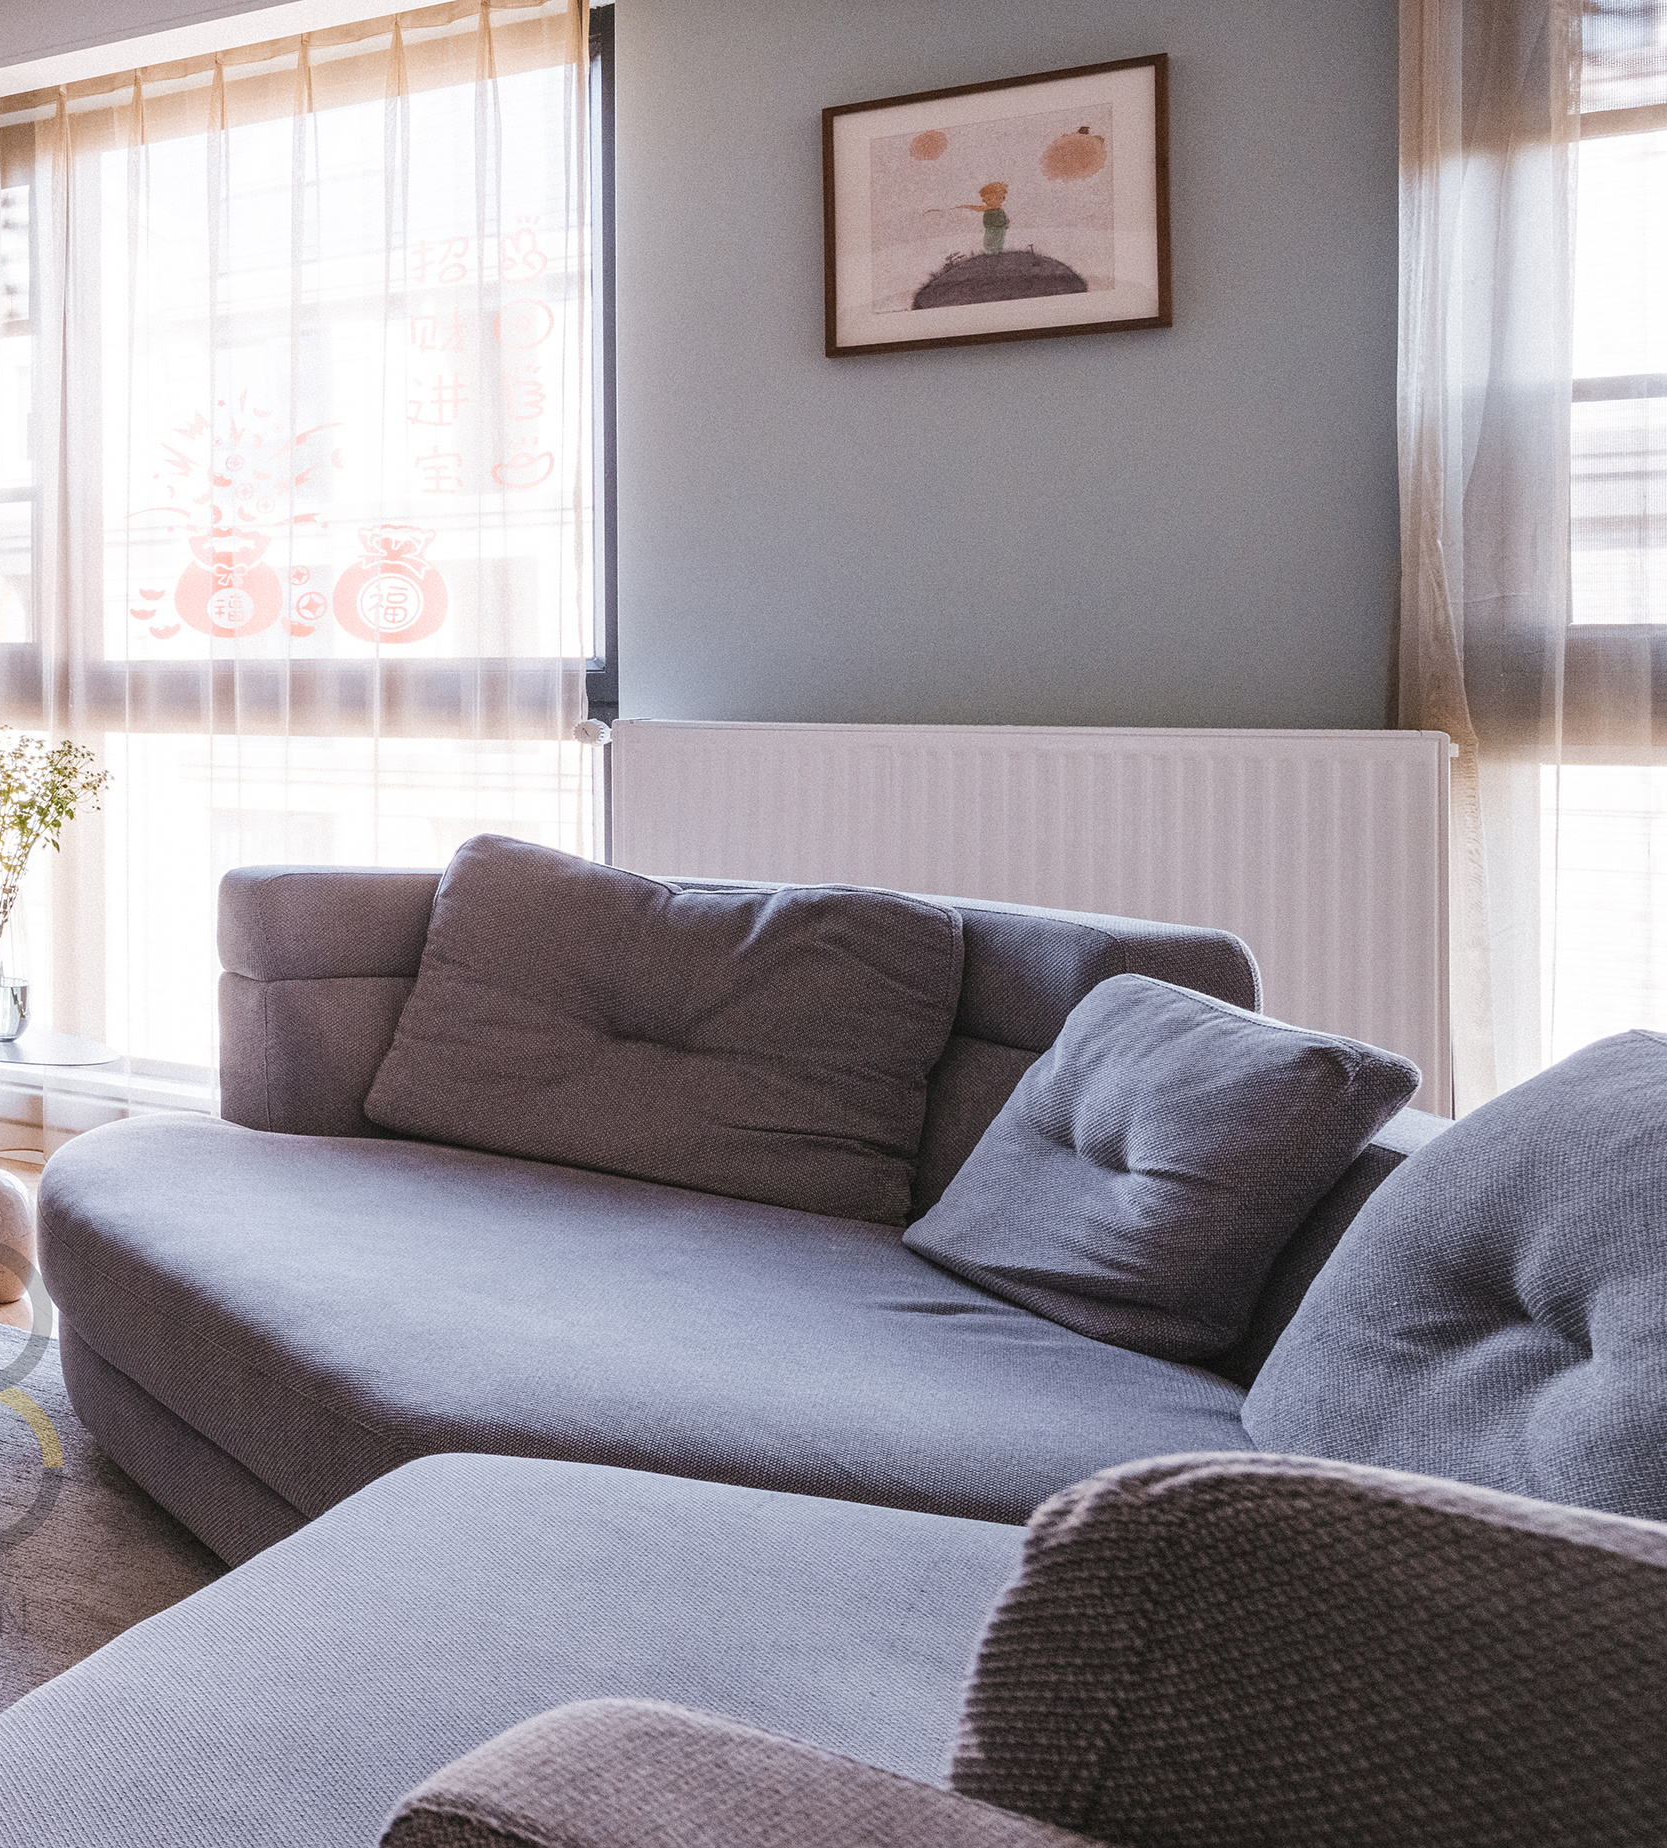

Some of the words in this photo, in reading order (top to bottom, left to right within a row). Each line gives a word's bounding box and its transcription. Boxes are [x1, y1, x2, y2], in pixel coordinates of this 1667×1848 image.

[408, 236, 470, 497] 招财进宝
[214, 594, 248, 624] 福
[369, 586, 412, 624] 福
